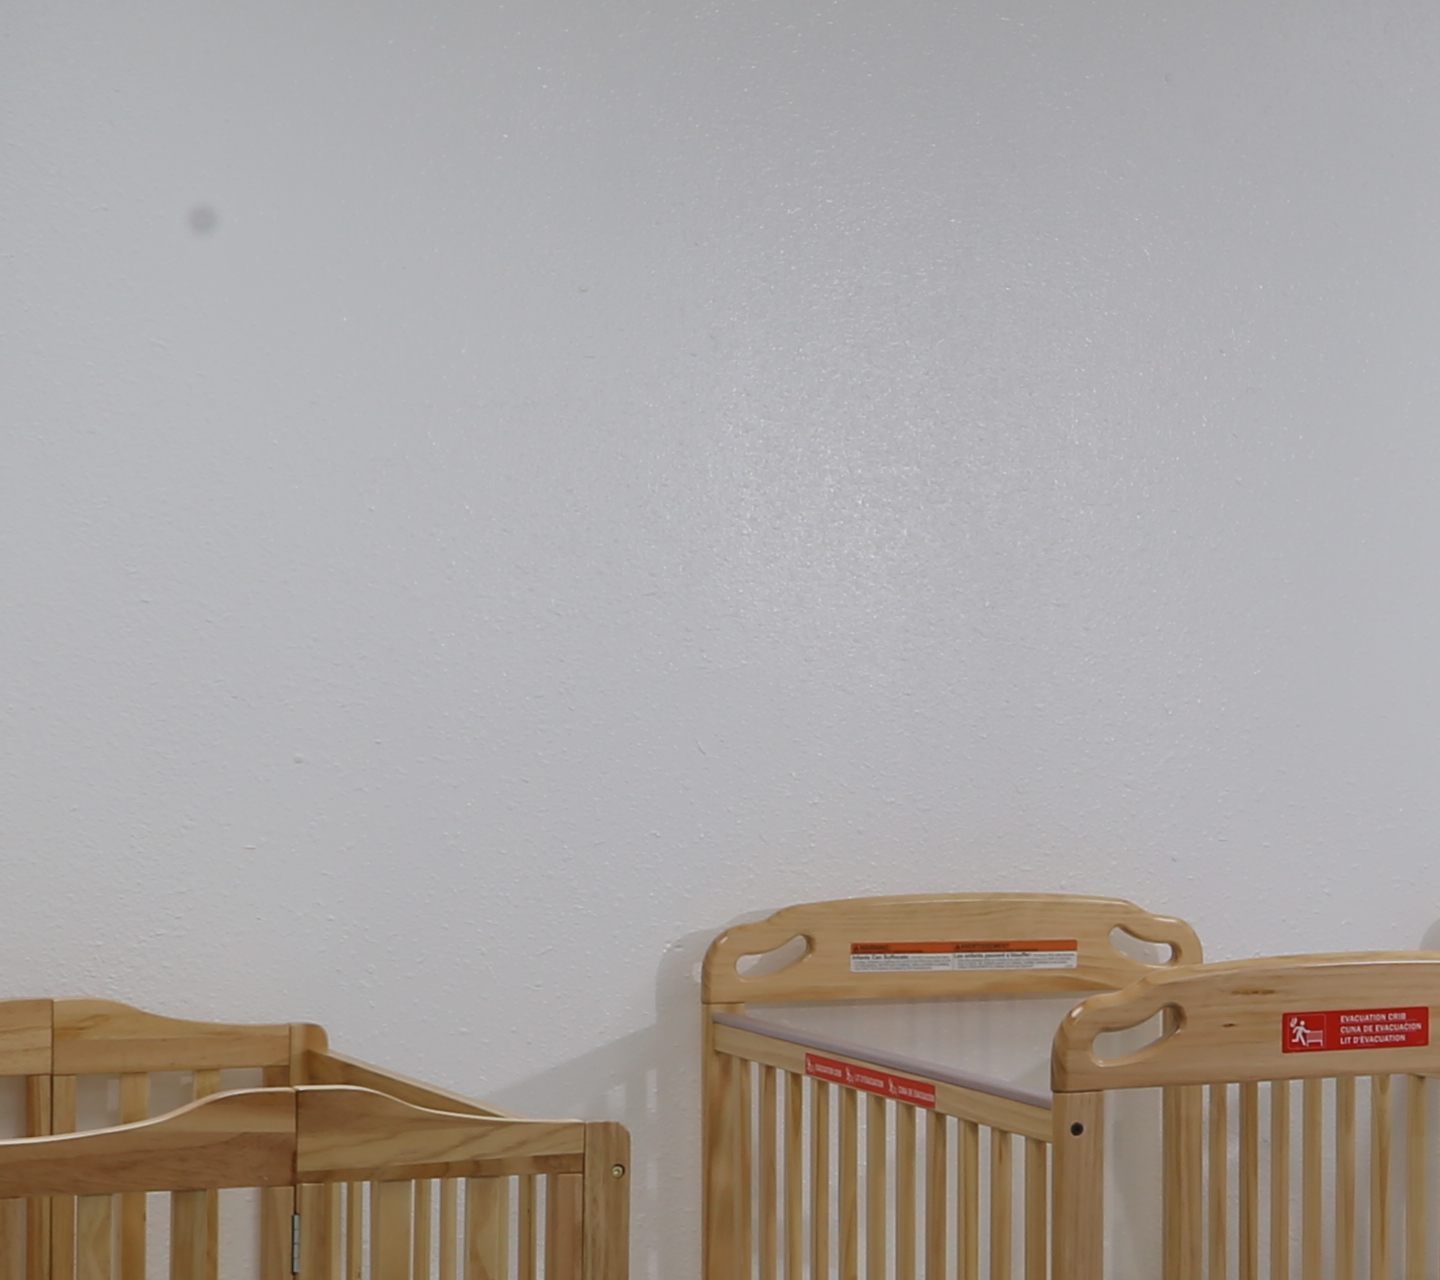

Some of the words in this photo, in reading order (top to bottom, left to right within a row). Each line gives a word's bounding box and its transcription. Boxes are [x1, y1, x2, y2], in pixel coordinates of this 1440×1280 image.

[1340, 1013, 1386, 1023] EVACUATION
[1388, 1012, 1406, 1020] CRIB
[1340, 1025, 1362, 1034] CUNA
[1363, 1024, 1373, 1032] DE
[1340, 1036, 1351, 1045] LIT
